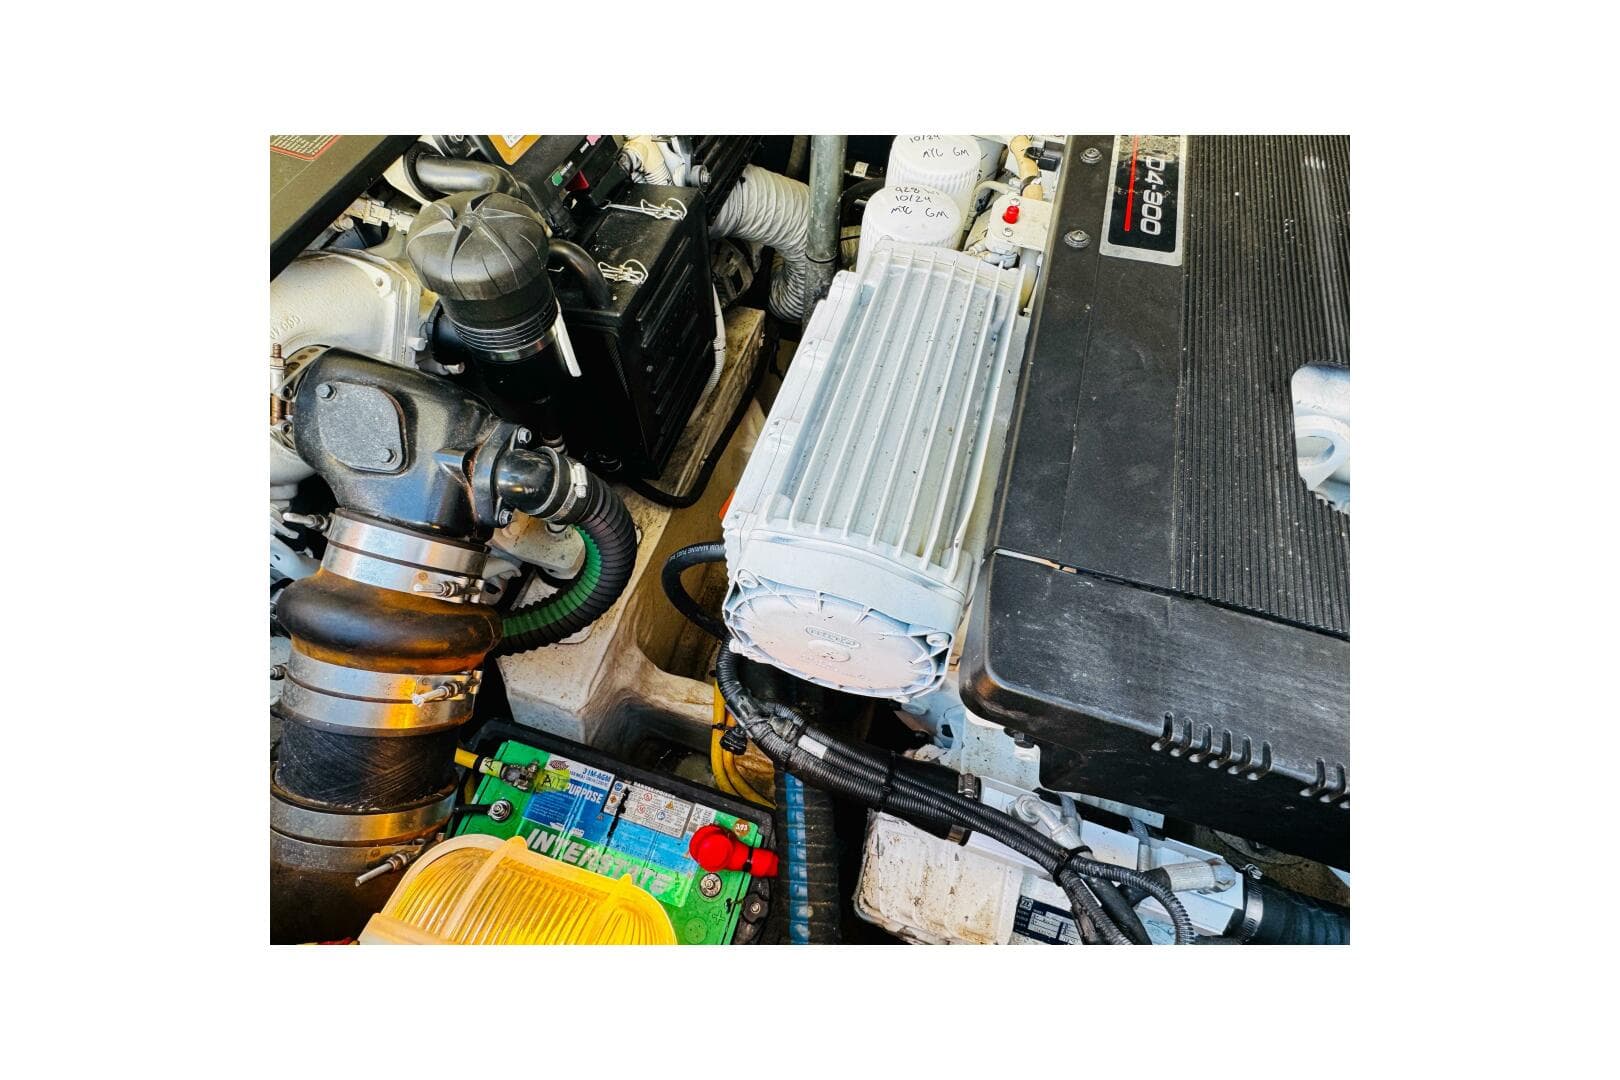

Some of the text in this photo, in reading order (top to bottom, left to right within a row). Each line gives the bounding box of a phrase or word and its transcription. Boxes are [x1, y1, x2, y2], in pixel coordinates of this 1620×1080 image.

[895, 194, 932, 204] 10/24
[925, 207, 950, 220] GM
[567, 782, 604, 804] PURPOSE
[526, 828, 673, 895] INTERSTATE
